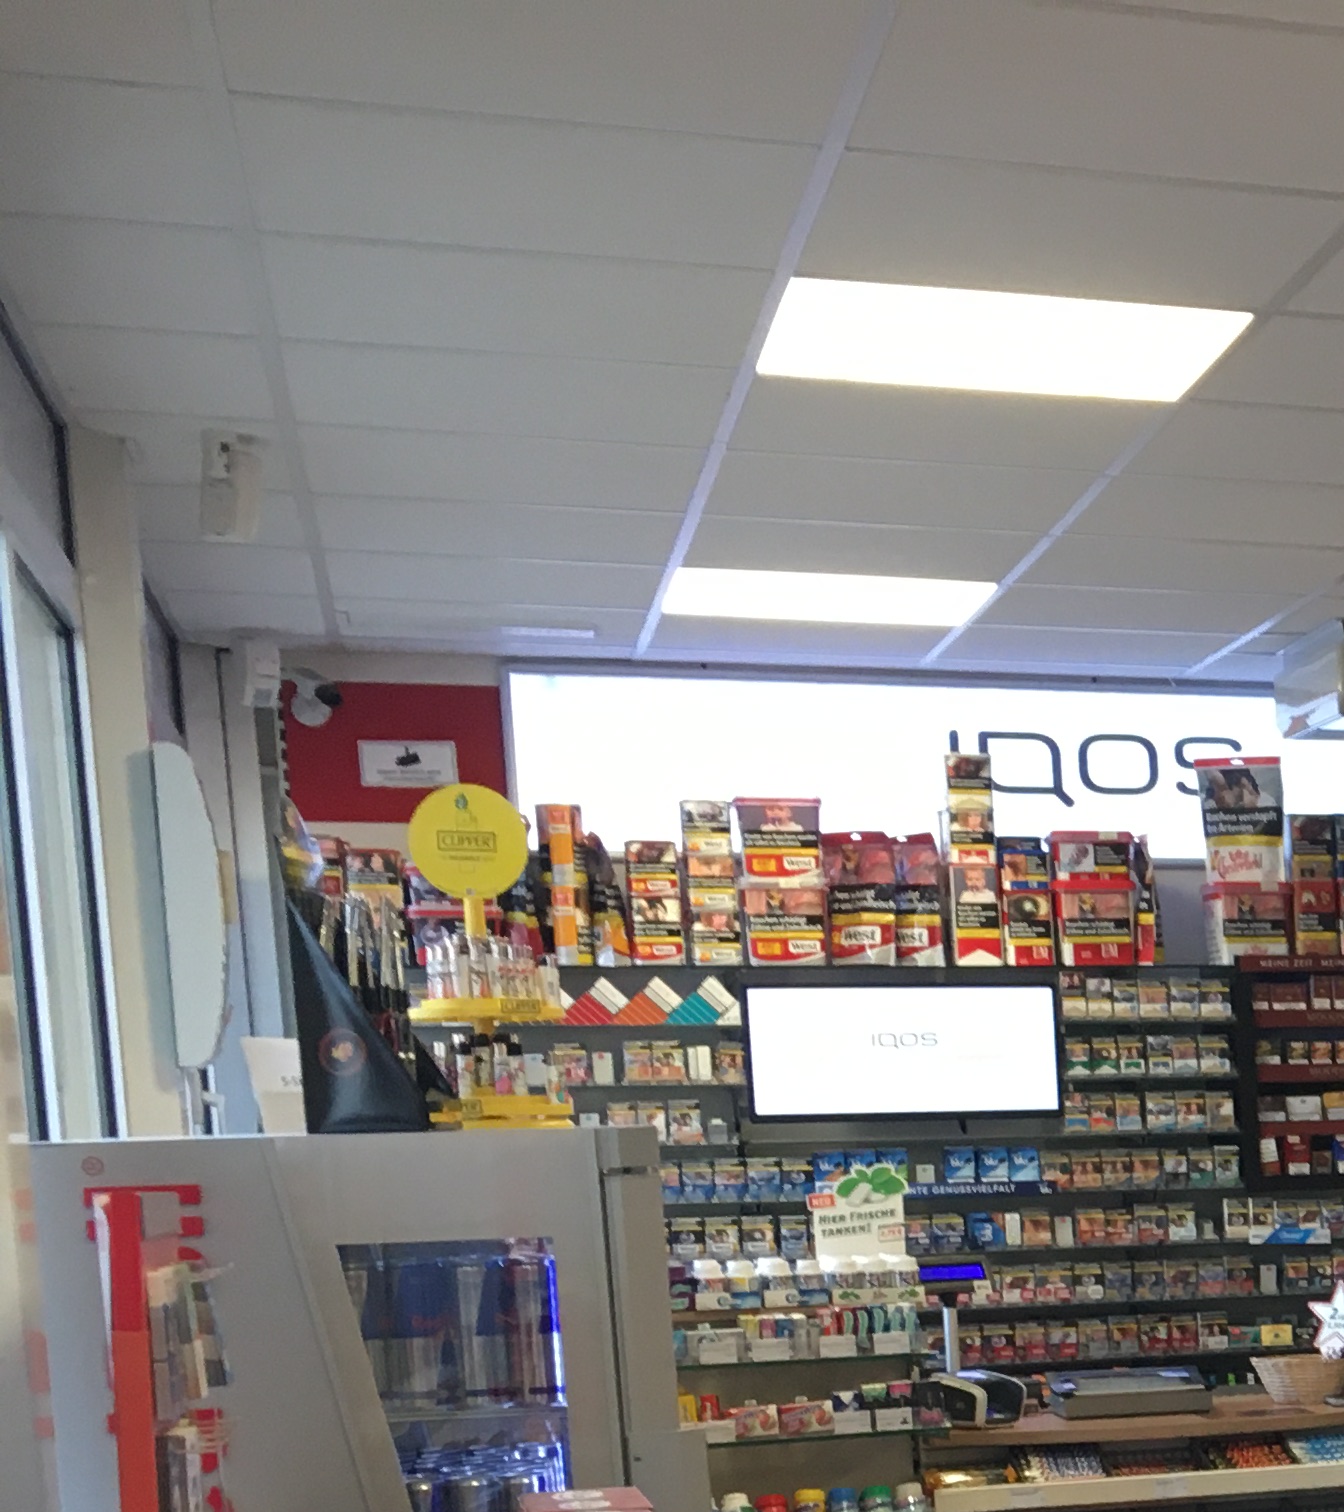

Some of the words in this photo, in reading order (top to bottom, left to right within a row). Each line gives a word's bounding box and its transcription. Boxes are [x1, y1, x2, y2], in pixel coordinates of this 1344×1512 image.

[440, 833, 493, 849] CLIPPER
[843, 927, 876, 944] West
[871, 1031, 939, 1050] IQOS
